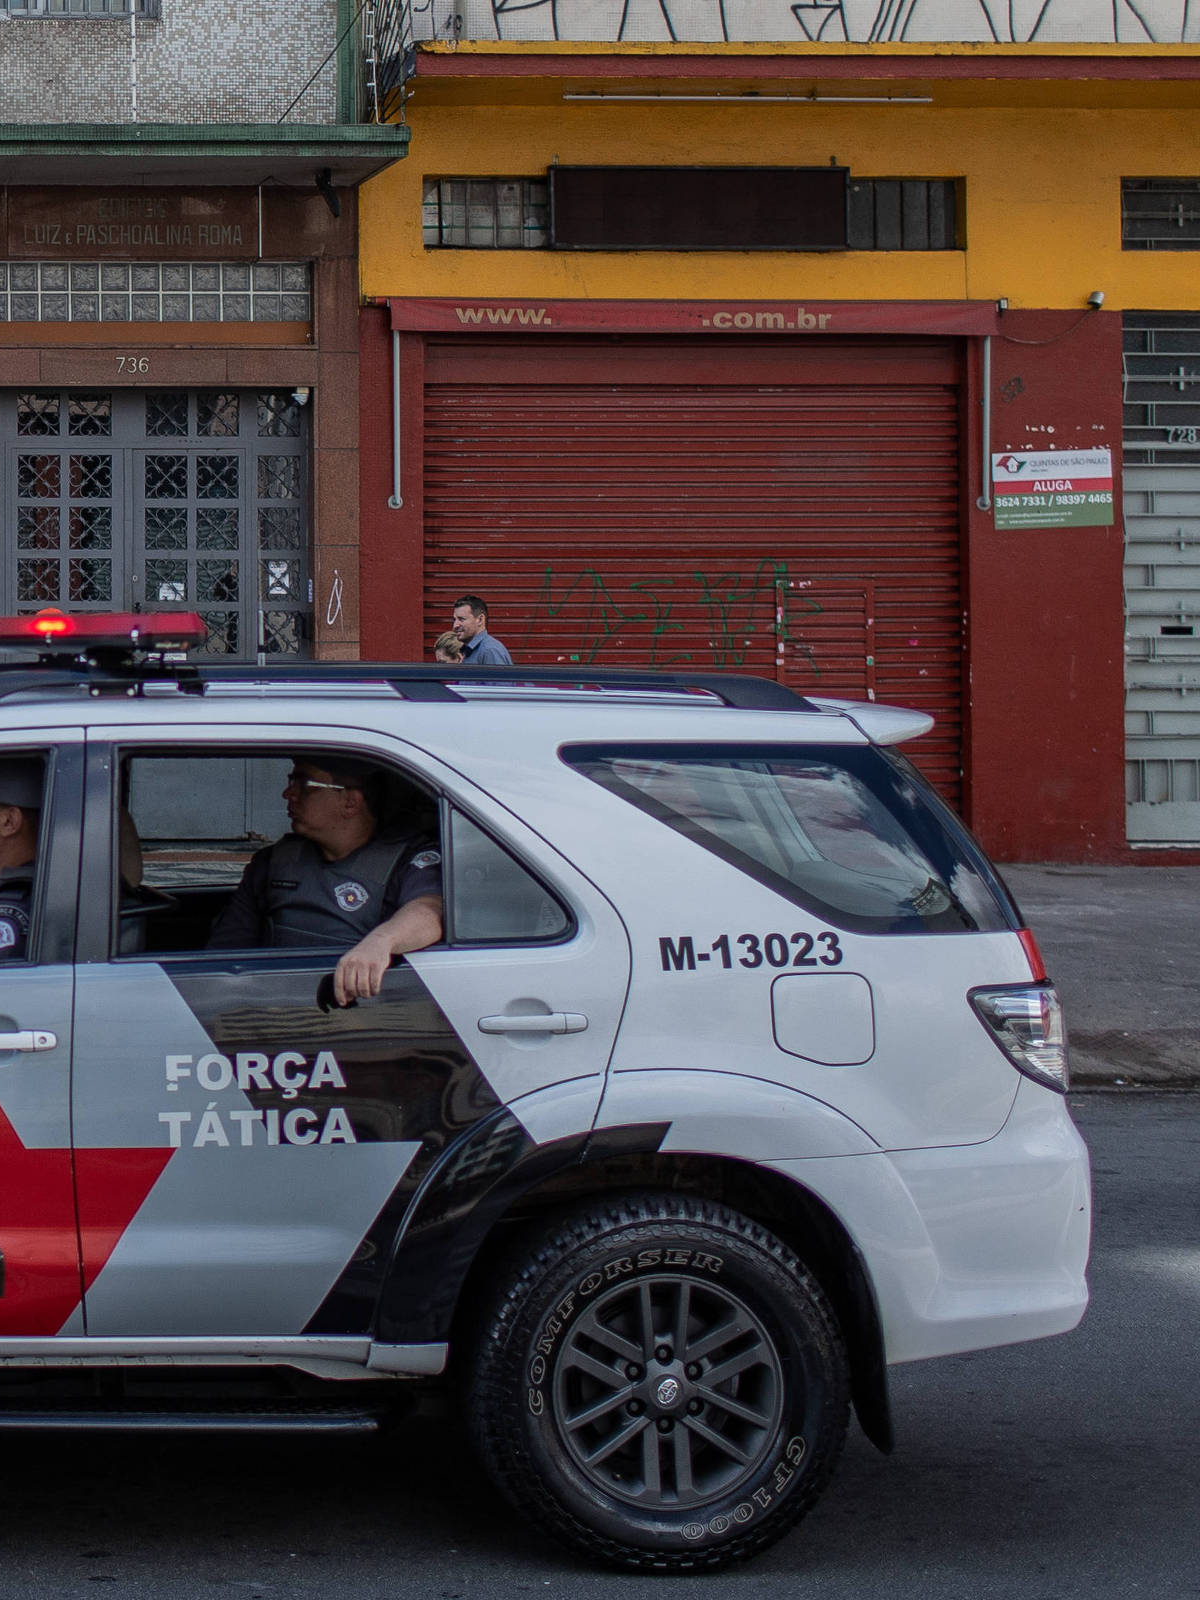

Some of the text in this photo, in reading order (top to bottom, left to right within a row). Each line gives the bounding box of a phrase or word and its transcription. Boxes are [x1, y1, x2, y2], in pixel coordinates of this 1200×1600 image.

[24, 225, 61, 245] LUIZ
[77, 224, 192, 245] PASCHOALINA
[198, 224, 242, 245] ROMA
[456, 308, 831, 330] www. .com.br
[115, 356, 149, 373] 736
[1167, 427, 1196, 443] 728
[1029, 459, 1060, 468] QUINTAS
[1061, 458, 1070, 466] DE
[1033, 480, 1072, 492] ALUGA
[995, 497, 1020, 508] 3624
[1022, 496, 1046, 507] 7331
[1055, 495, 1086, 506] 98397
[1088, 493, 1113, 505] 4465
[659, 931, 843, 971] M-13023
[165, 1051, 347, 1099] FORÇA
[158, 1102, 357, 1147] TÁTICA
[528, 1249, 724, 1416] COMFORSER
